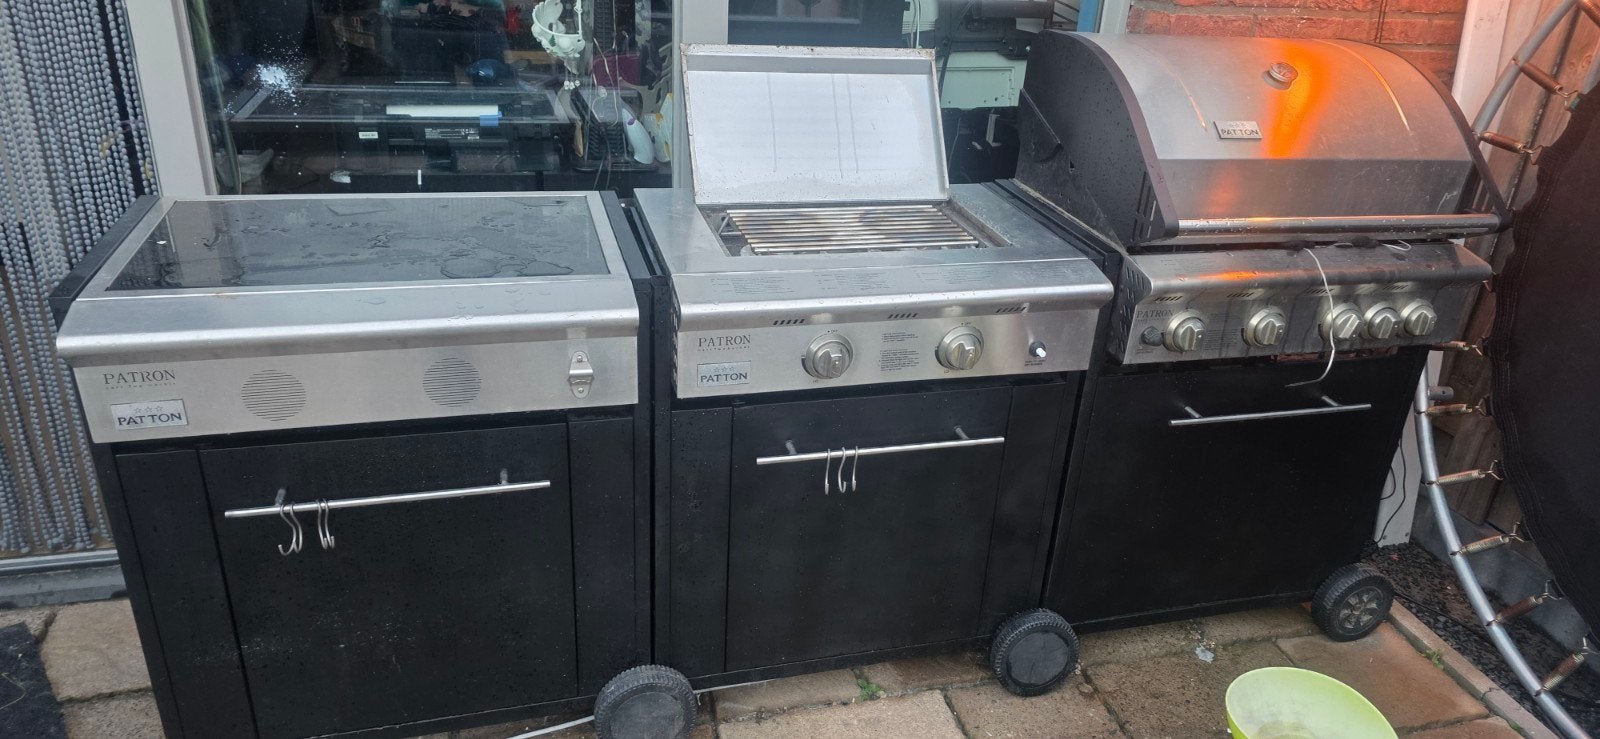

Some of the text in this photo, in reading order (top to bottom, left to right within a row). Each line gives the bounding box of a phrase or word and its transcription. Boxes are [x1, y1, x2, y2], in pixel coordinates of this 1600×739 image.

[1136, 309, 1174, 319] PATRON
[698, 334, 751, 347] PATRON
[102, 369, 176, 385] PATRON
[700, 372, 748, 382] PATTON
[117, 412, 182, 425] PATTON
